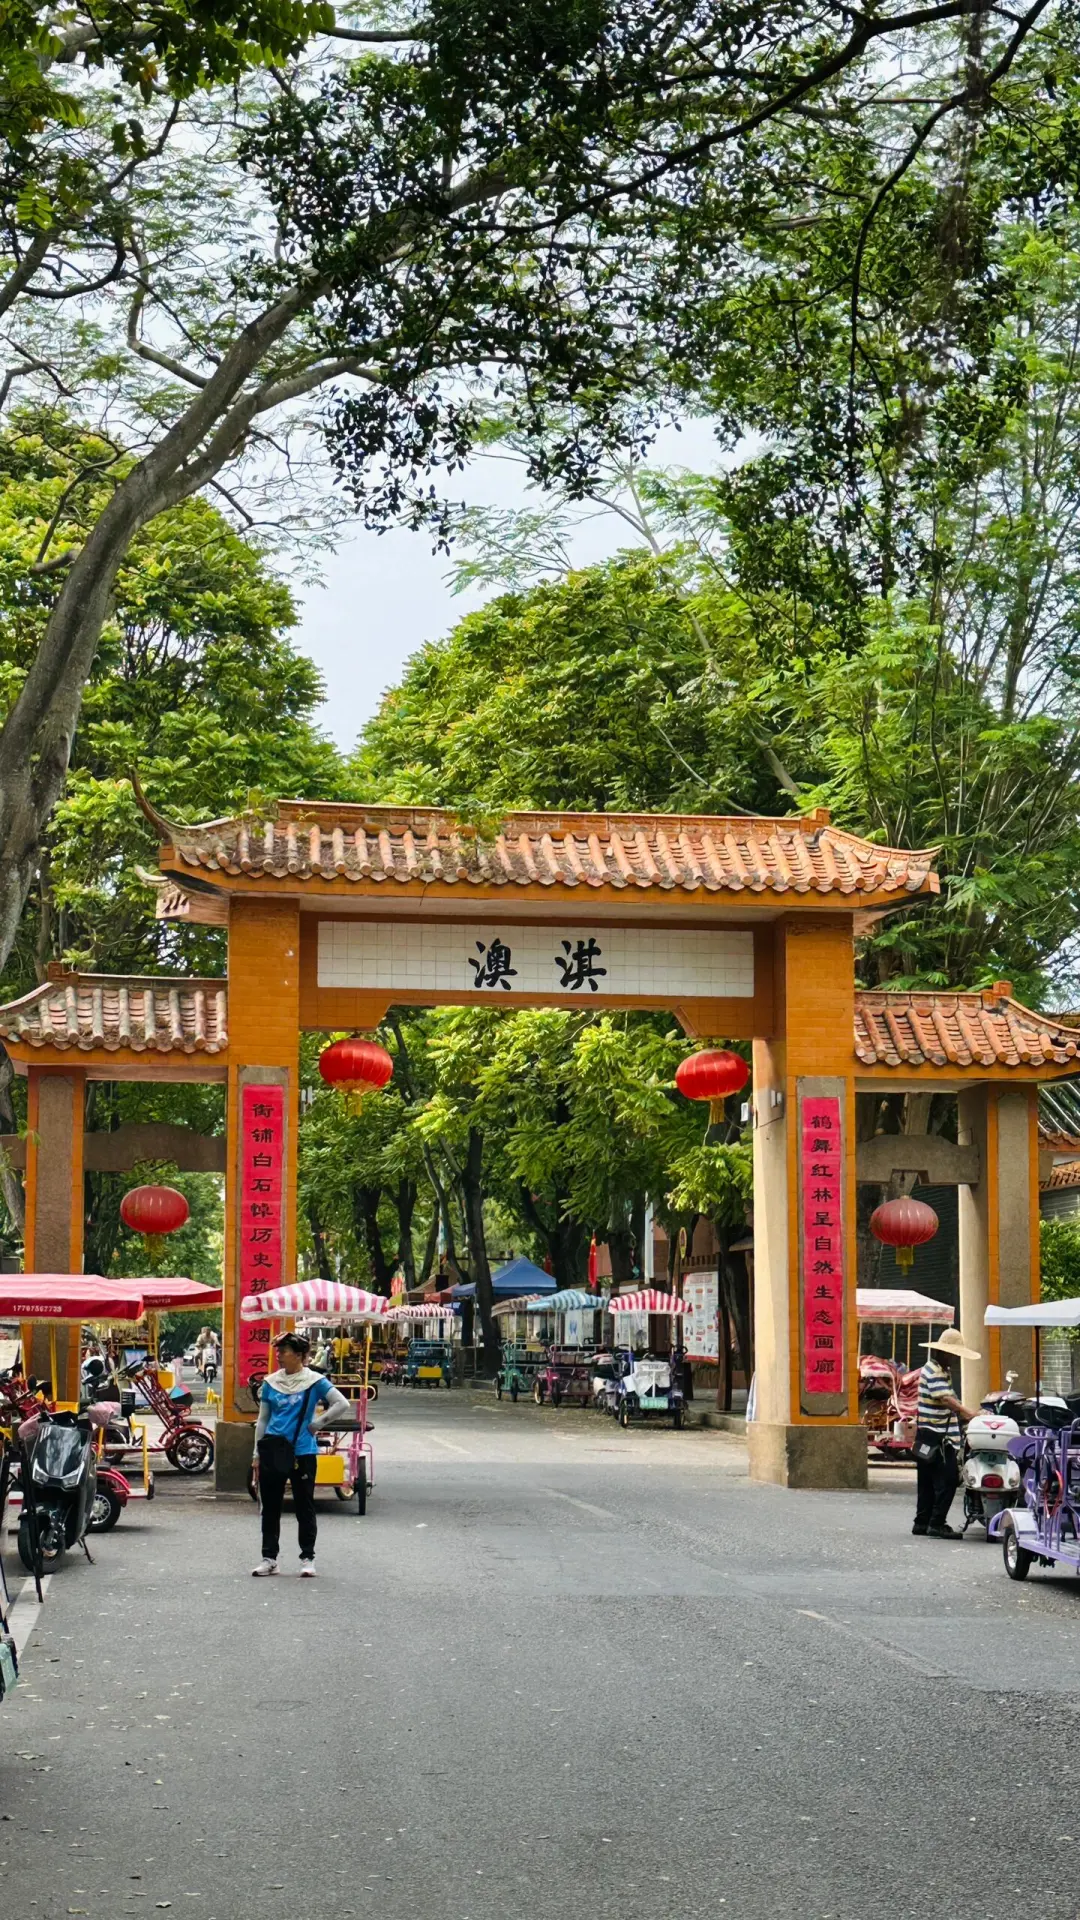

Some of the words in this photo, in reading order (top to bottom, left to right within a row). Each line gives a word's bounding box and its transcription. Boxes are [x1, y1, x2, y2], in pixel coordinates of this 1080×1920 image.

[811, 1115, 835, 1374] 鹤舞红林呈自然生态画廊
